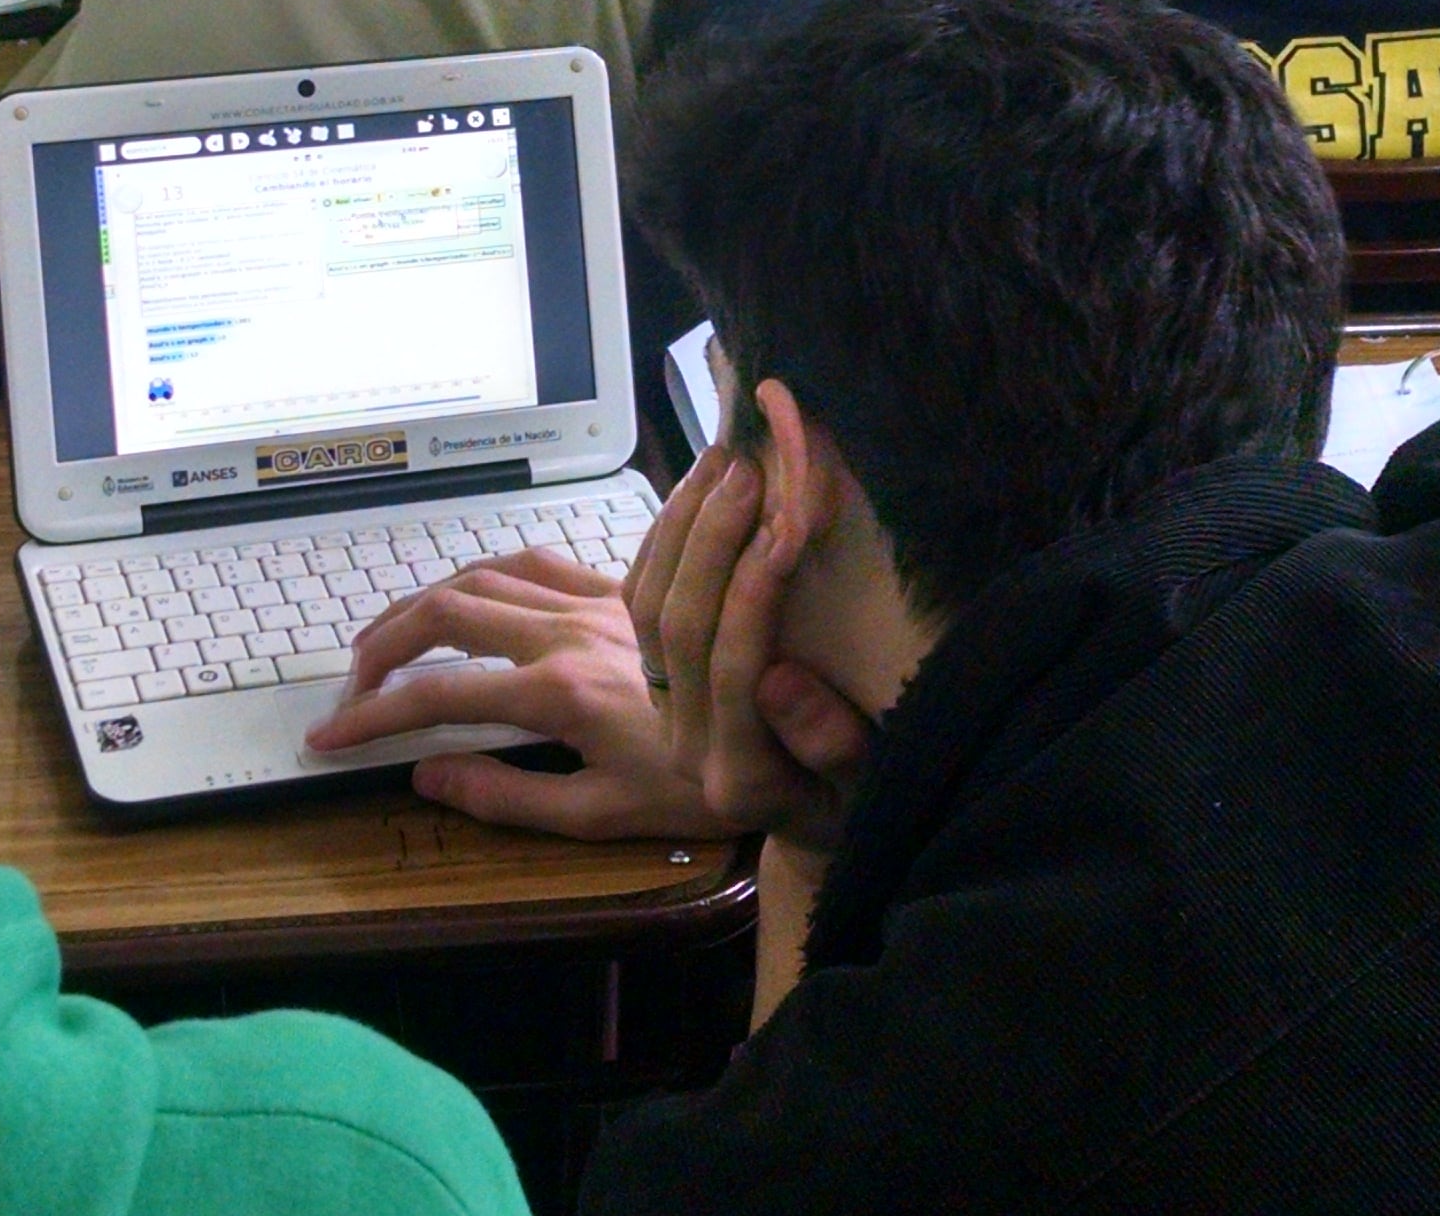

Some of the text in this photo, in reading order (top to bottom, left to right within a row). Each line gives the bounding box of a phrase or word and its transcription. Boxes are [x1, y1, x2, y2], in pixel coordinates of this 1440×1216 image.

[444, 435, 496, 450] Presidencia
[499, 434, 511, 444] de
[514, 432, 522, 442] la
[272, 438, 394, 474] CARC
[190, 467, 238, 483] ANSES
